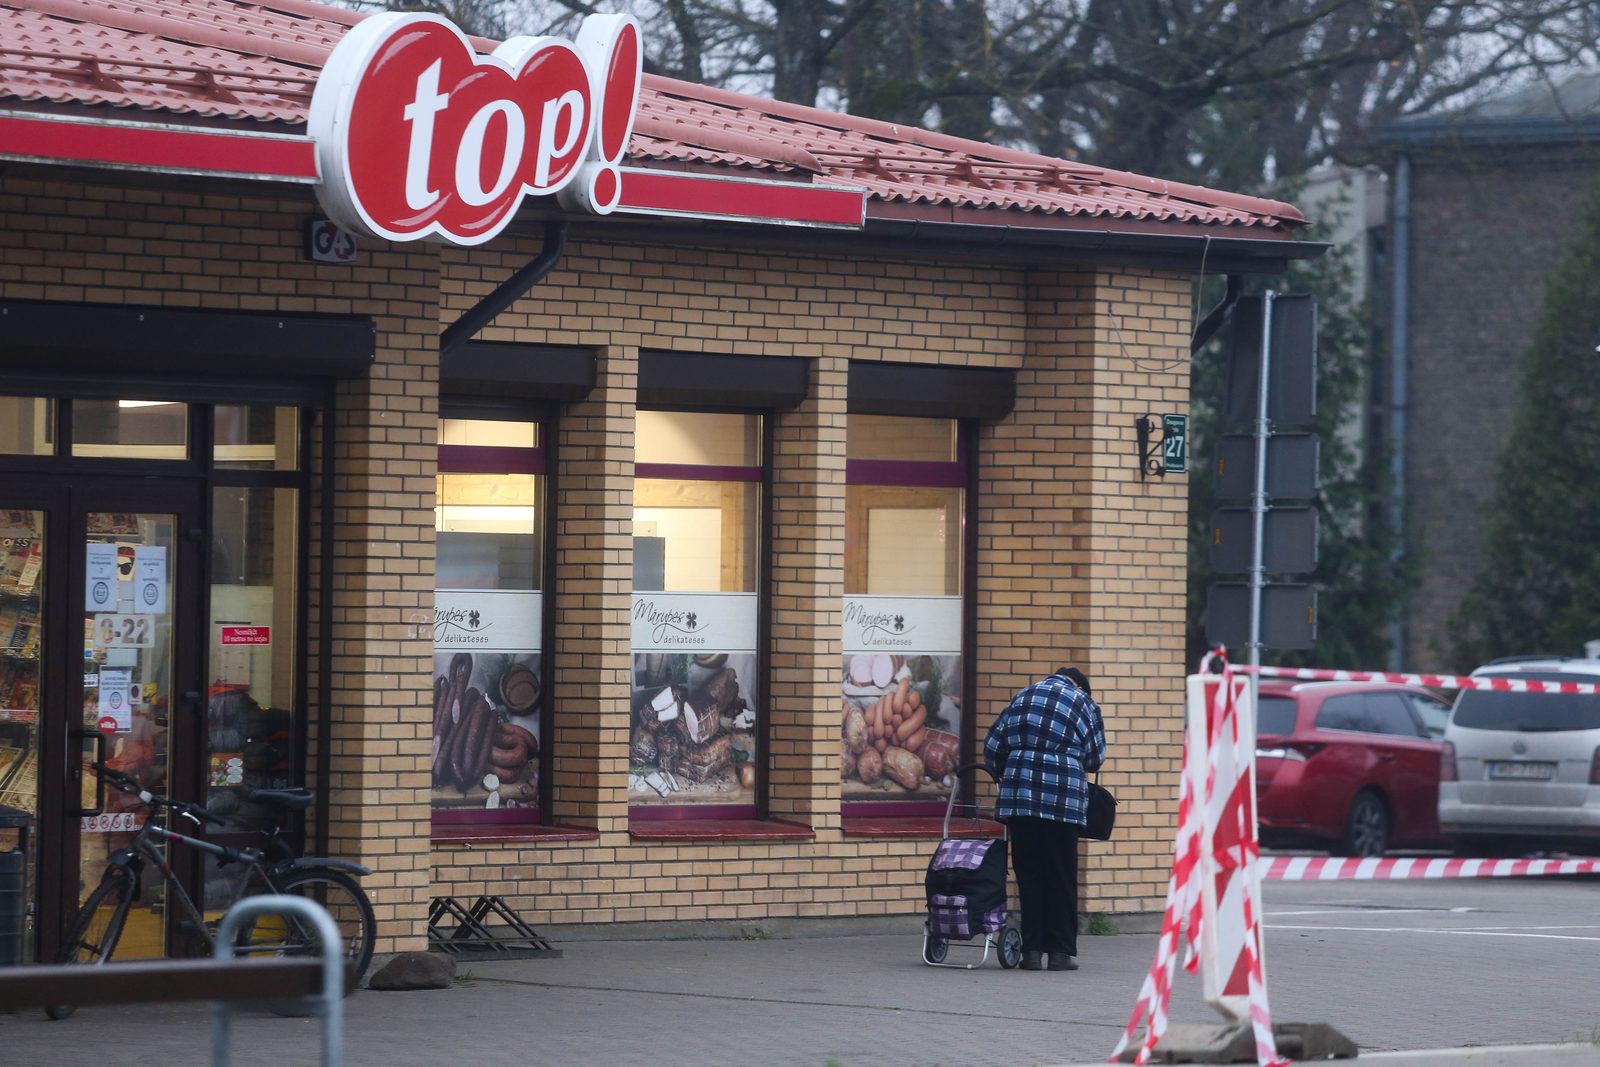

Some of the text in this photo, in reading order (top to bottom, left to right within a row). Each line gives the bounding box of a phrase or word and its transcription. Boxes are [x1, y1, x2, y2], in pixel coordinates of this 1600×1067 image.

[403, 20, 640, 212] top!
[1166, 435, 1184, 457] 27
[444, 634, 489, 643] delikateses
[663, 635, 705, 644] delikateses
[872, 637, 912, 646] delikateses
